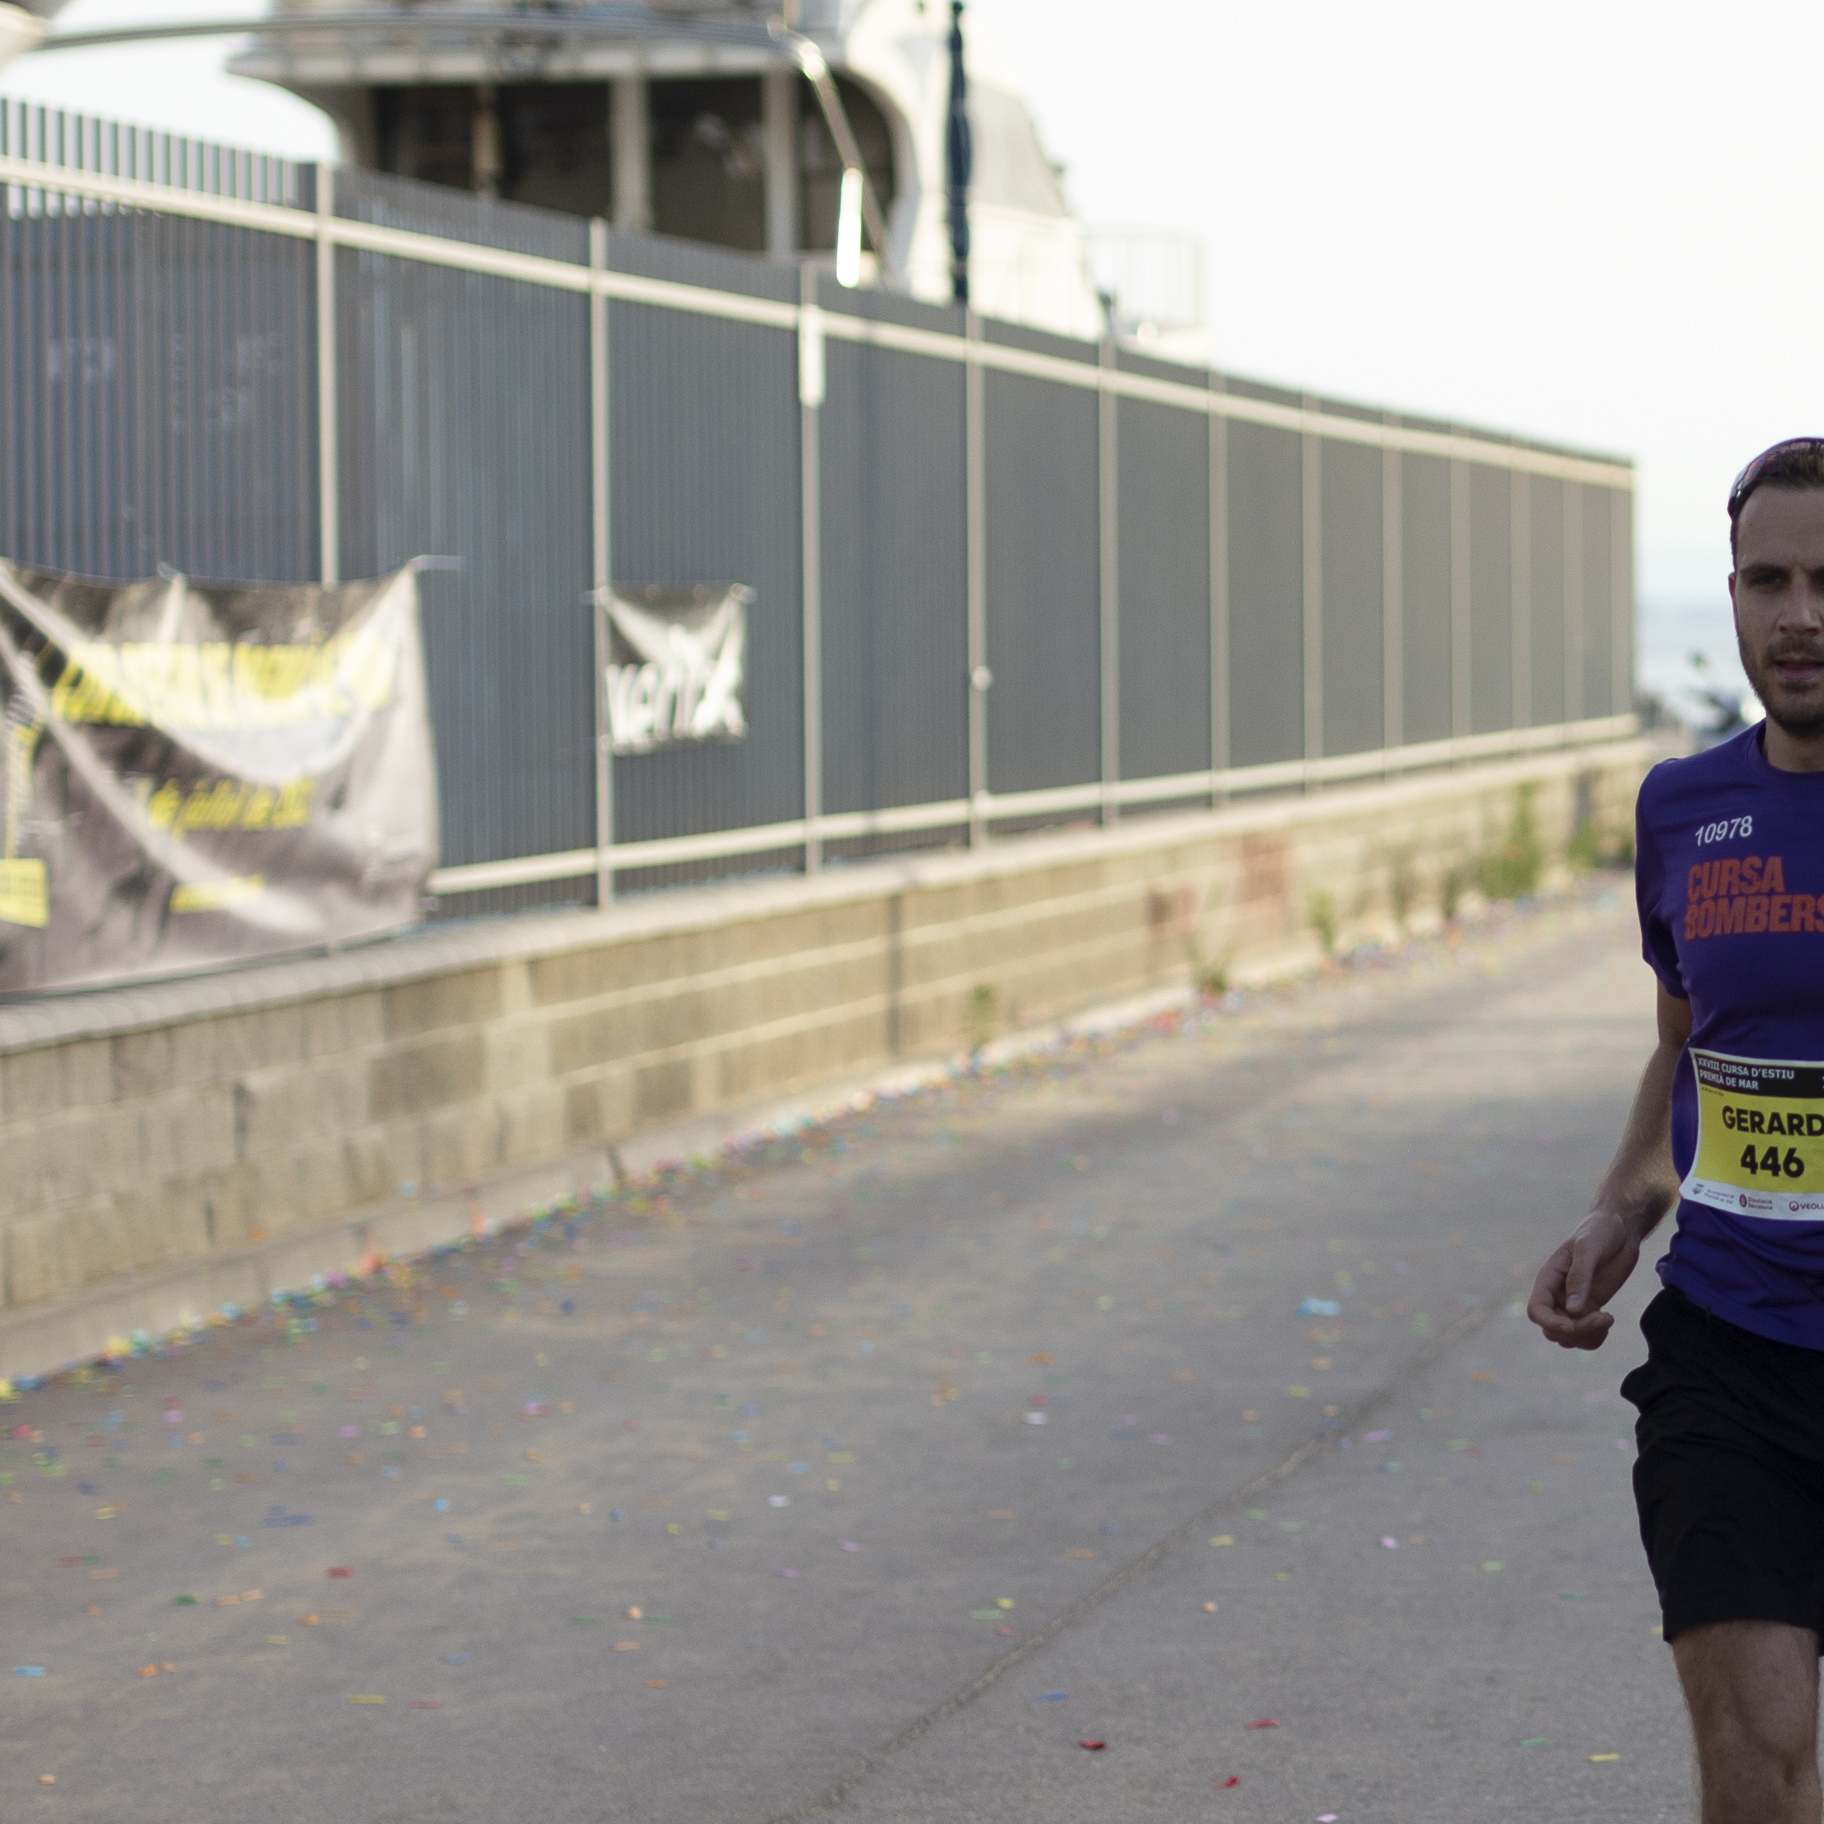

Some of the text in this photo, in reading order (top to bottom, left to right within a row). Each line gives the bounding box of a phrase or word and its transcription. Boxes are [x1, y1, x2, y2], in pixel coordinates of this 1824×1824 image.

[1694, 814, 1753, 847] 10978
[1687, 855, 1785, 902] CURSA
[1721, 1063, 1749, 1076] CURSA
[1751, 1067, 1795, 1080] D'ESTIU
[1725, 1076, 1737, 1087] DE
[1738, 1078, 1759, 1090] MAR
[1740, 1143, 1805, 1178] 446
